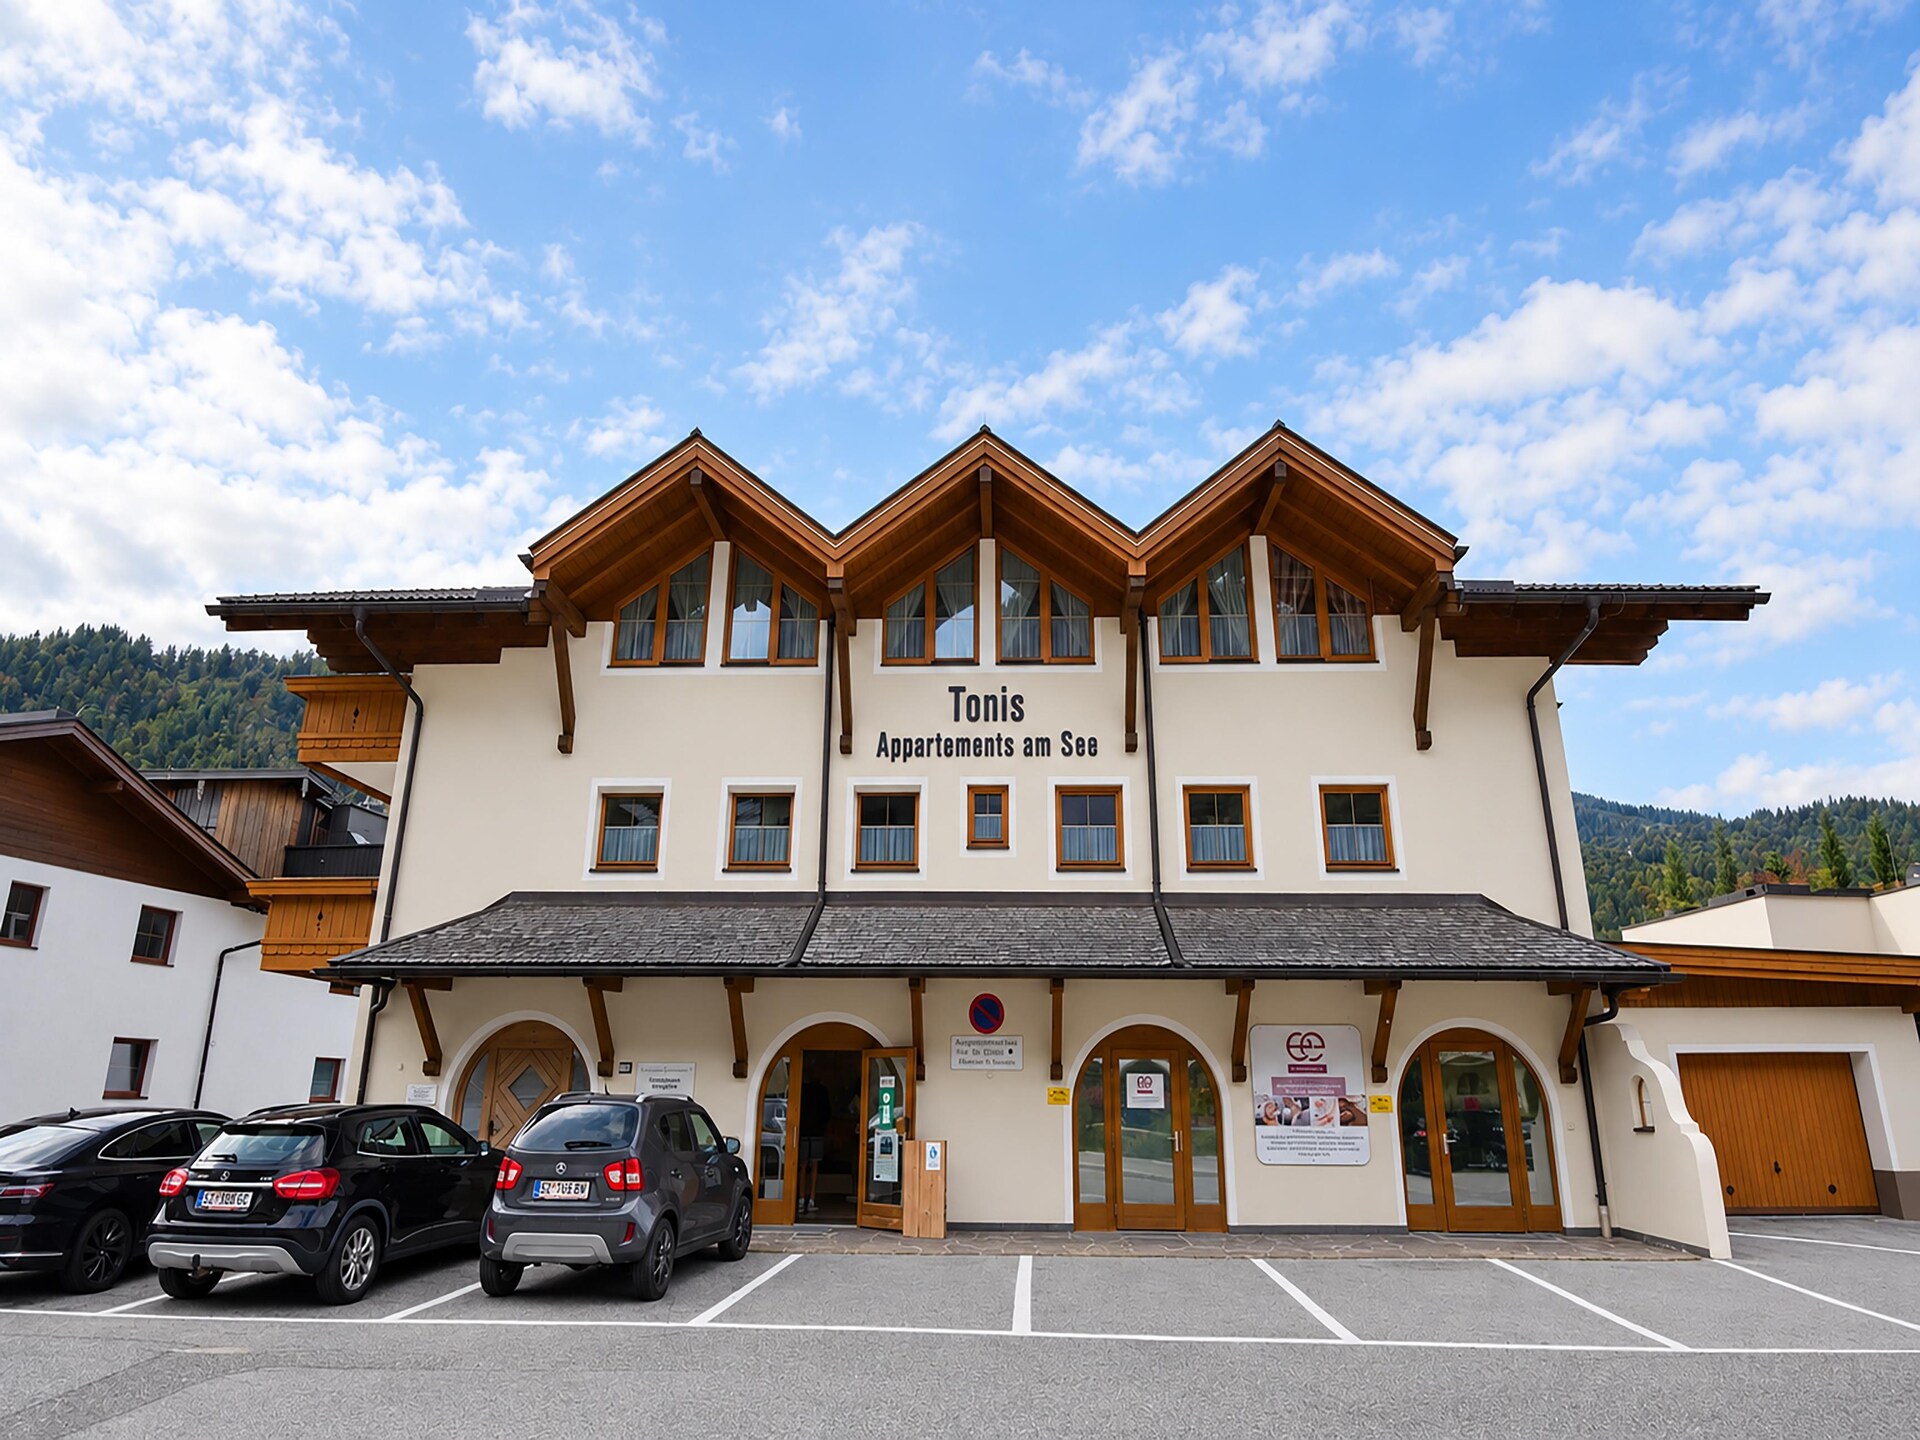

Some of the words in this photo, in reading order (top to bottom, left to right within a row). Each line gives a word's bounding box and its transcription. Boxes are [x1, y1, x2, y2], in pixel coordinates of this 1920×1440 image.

[948, 685, 1025, 723] Tonis
[875, 731, 1015, 763] Appartements
[1022, 736, 1051, 758] am
[1060, 730, 1098, 758] See
